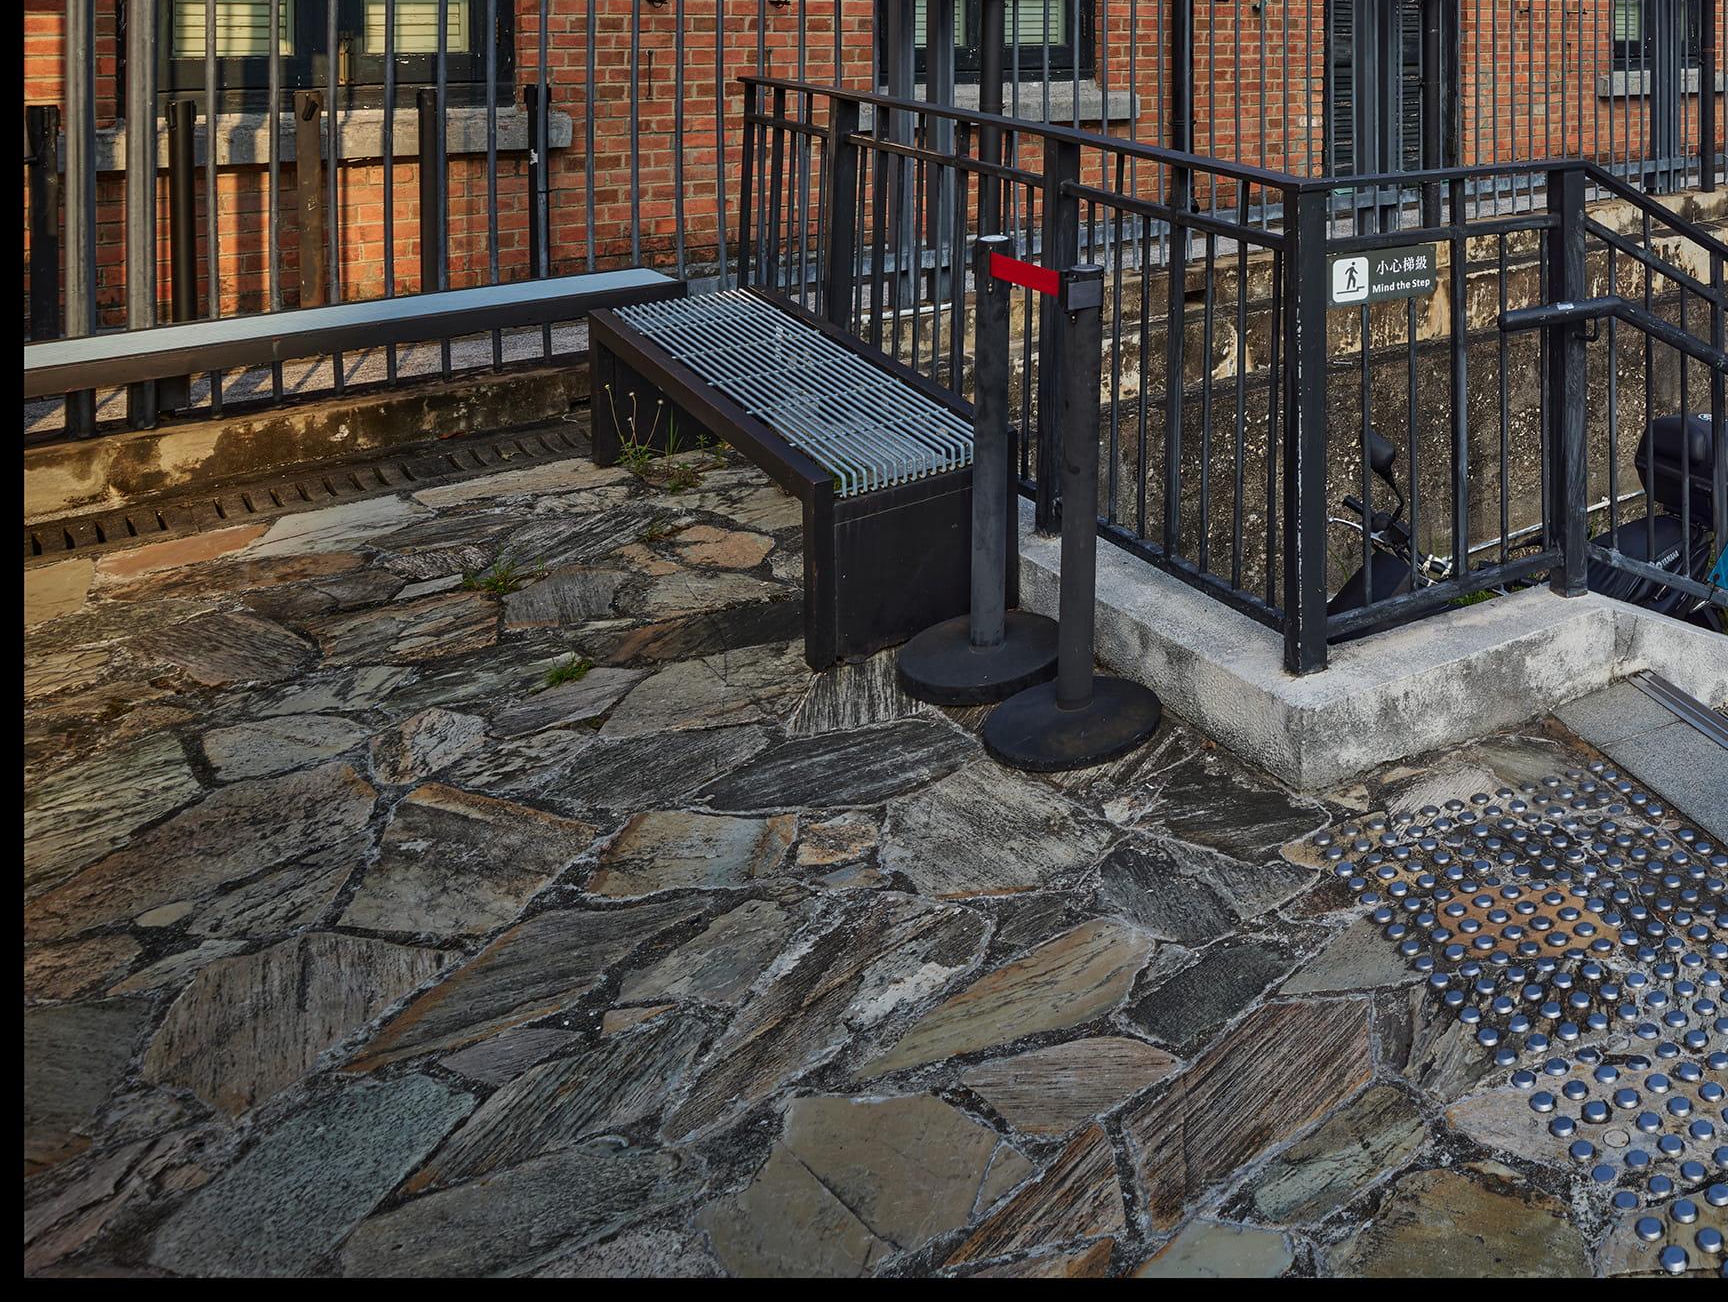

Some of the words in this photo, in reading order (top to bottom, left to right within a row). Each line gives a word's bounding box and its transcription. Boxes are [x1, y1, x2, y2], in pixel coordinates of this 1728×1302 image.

[1376, 255, 1427, 275] 小心梯級
[1372, 282, 1395, 294] Mind
[1396, 279, 1411, 290] the
[1411, 278, 1430, 288] Step
